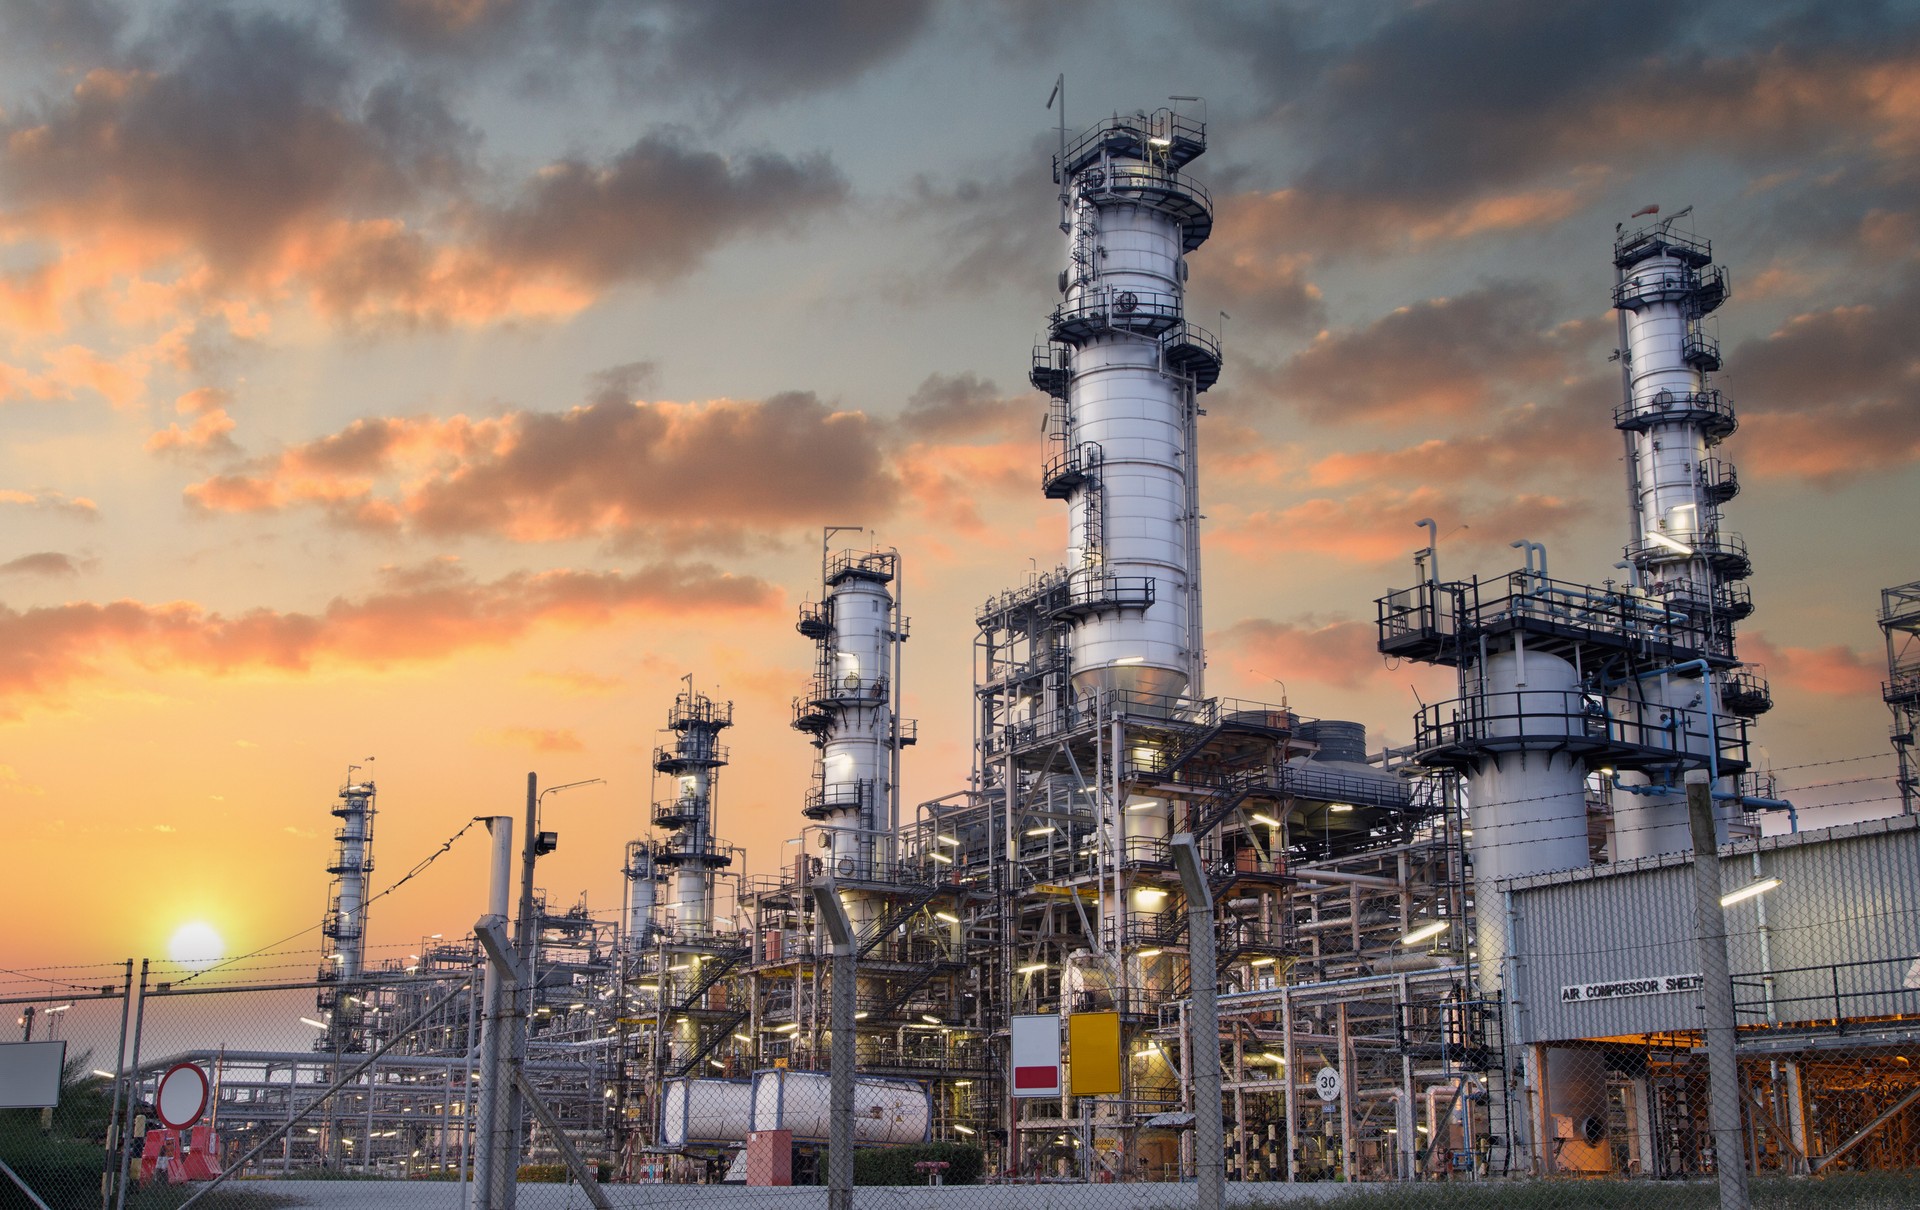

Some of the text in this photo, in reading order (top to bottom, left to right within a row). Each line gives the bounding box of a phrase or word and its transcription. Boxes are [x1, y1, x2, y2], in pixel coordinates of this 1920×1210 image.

[1562, 988, 1581, 1001] AIR
[1585, 980, 1659, 999] COMPRESSOR
[1321, 1076, 1336, 1089] 30
